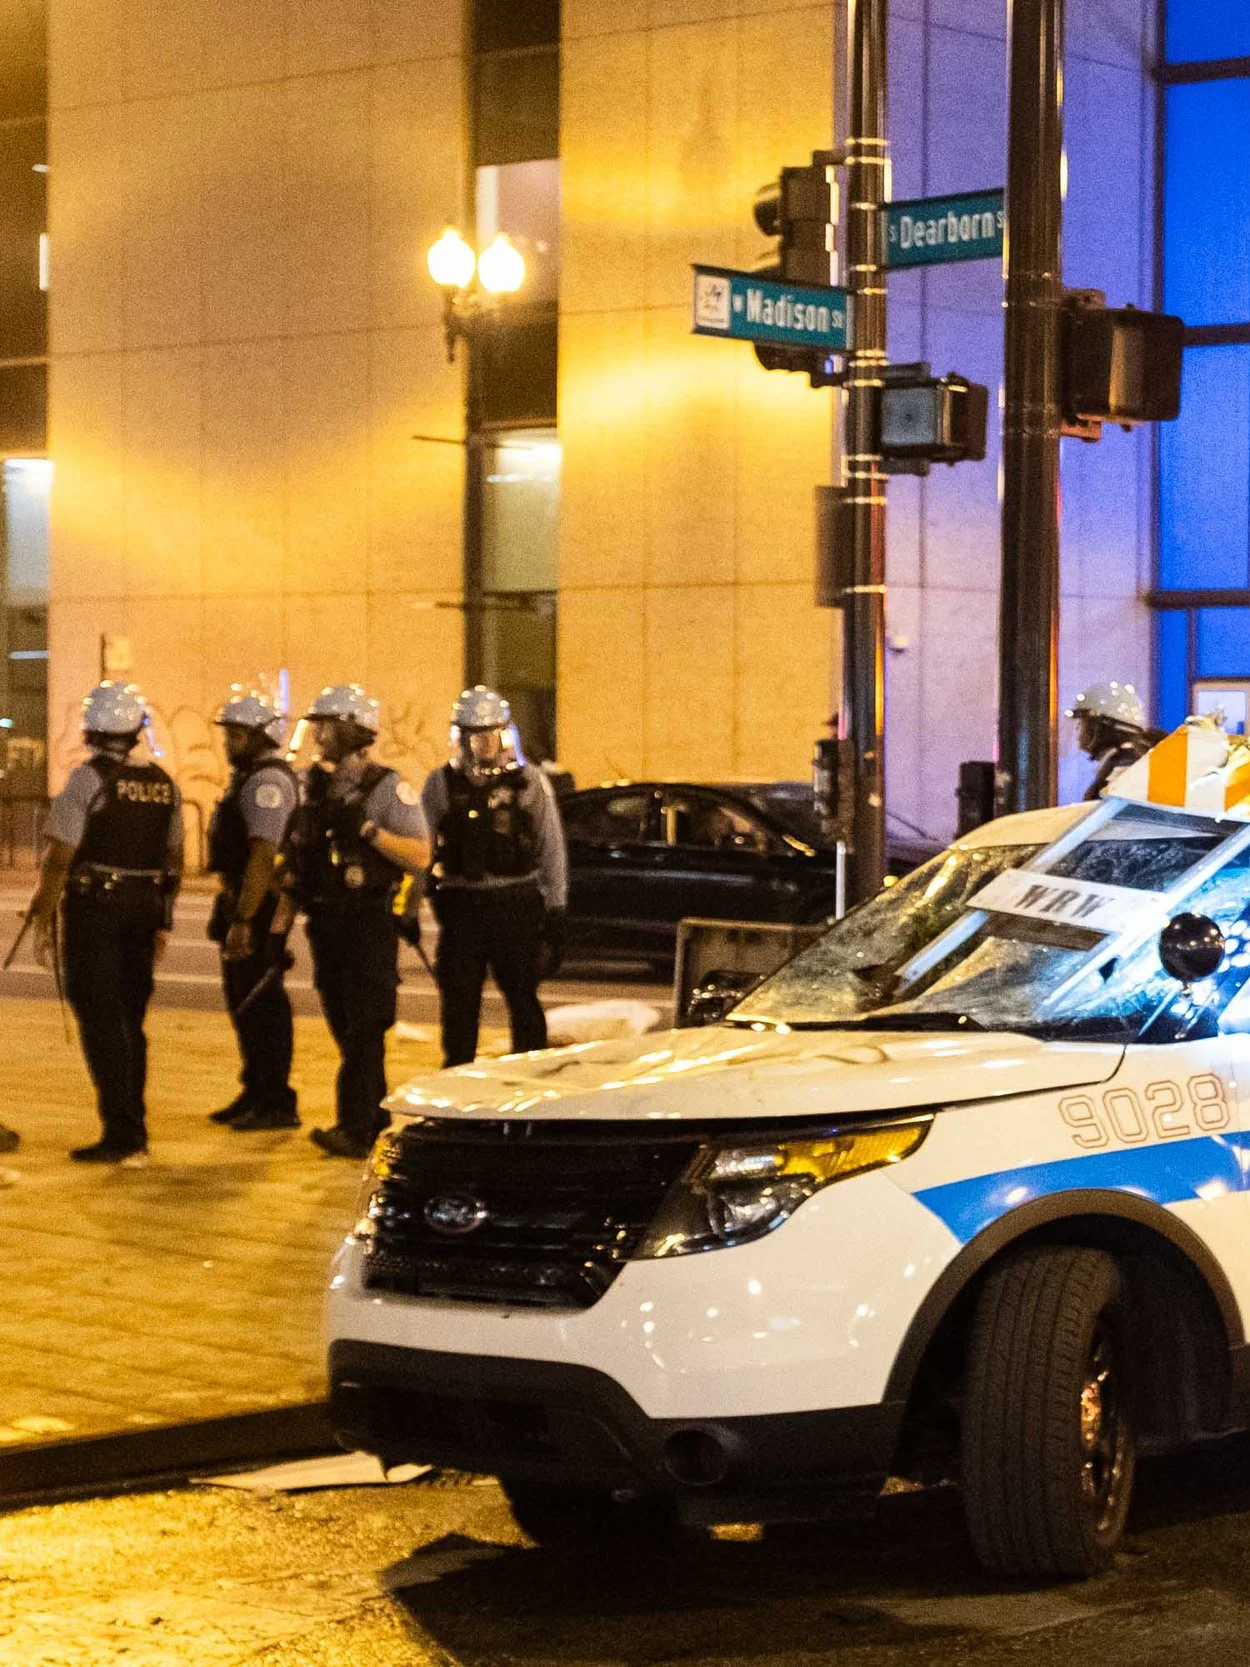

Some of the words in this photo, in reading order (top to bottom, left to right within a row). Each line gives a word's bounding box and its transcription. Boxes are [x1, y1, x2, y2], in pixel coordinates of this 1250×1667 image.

[889, 224, 897, 243] S
[899, 212, 995, 249] Dearborn
[732, 294, 744, 312] W
[746, 288, 831, 332] Madison
[117, 780, 170, 805] POLICE
[1058, 1072, 1230, 1149] 9028
